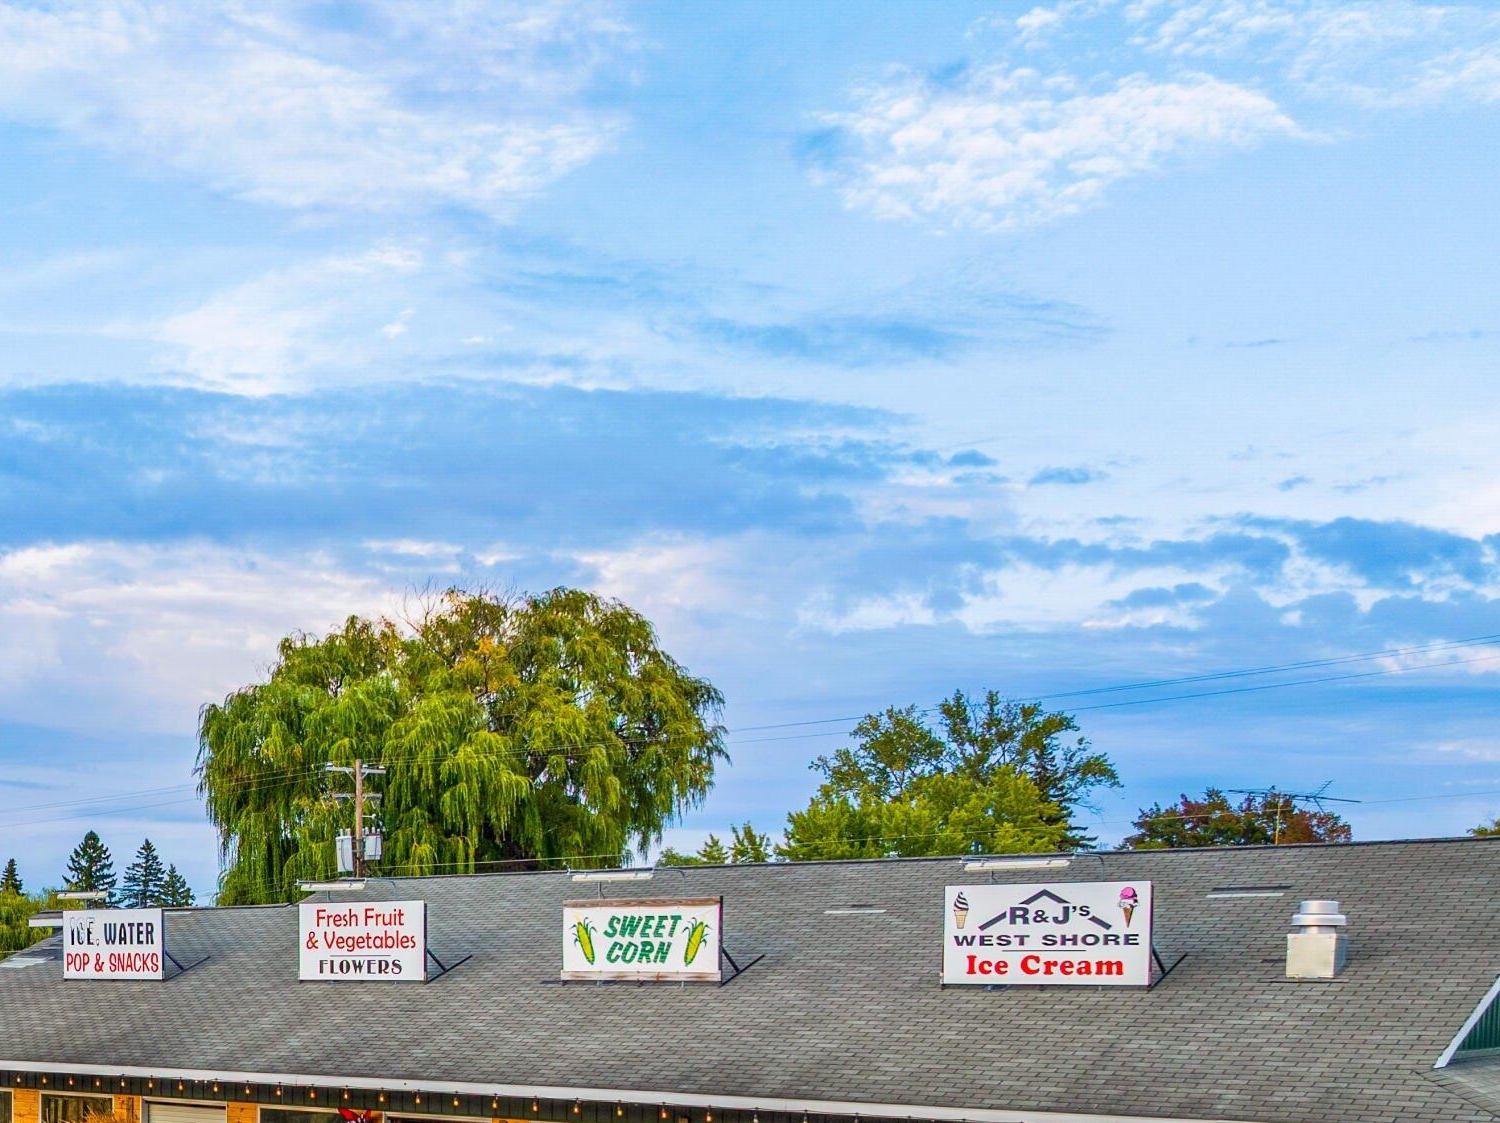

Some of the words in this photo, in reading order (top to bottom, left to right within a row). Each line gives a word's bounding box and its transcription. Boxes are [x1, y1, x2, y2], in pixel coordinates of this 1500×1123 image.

[316, 908, 359, 927] Fresh
[364, 908, 404, 926] Fruit
[603, 915, 682, 938] SWEET
[103, 922, 154, 945] WATER
[306, 931, 319, 949] &
[323, 930, 417, 952] Vegetables
[953, 934, 1030, 947] WEST
[1042, 934, 1139, 946] SHORE
[66, 953, 90, 972] POP
[94, 953, 105, 973] &
[109, 952, 159, 973] SNACKS
[606, 941, 672, 964] CORN
[319, 959, 403, 974] FLOWERS
[966, 955, 1008, 975] Ice
[1020, 955, 1124, 976] Cream
